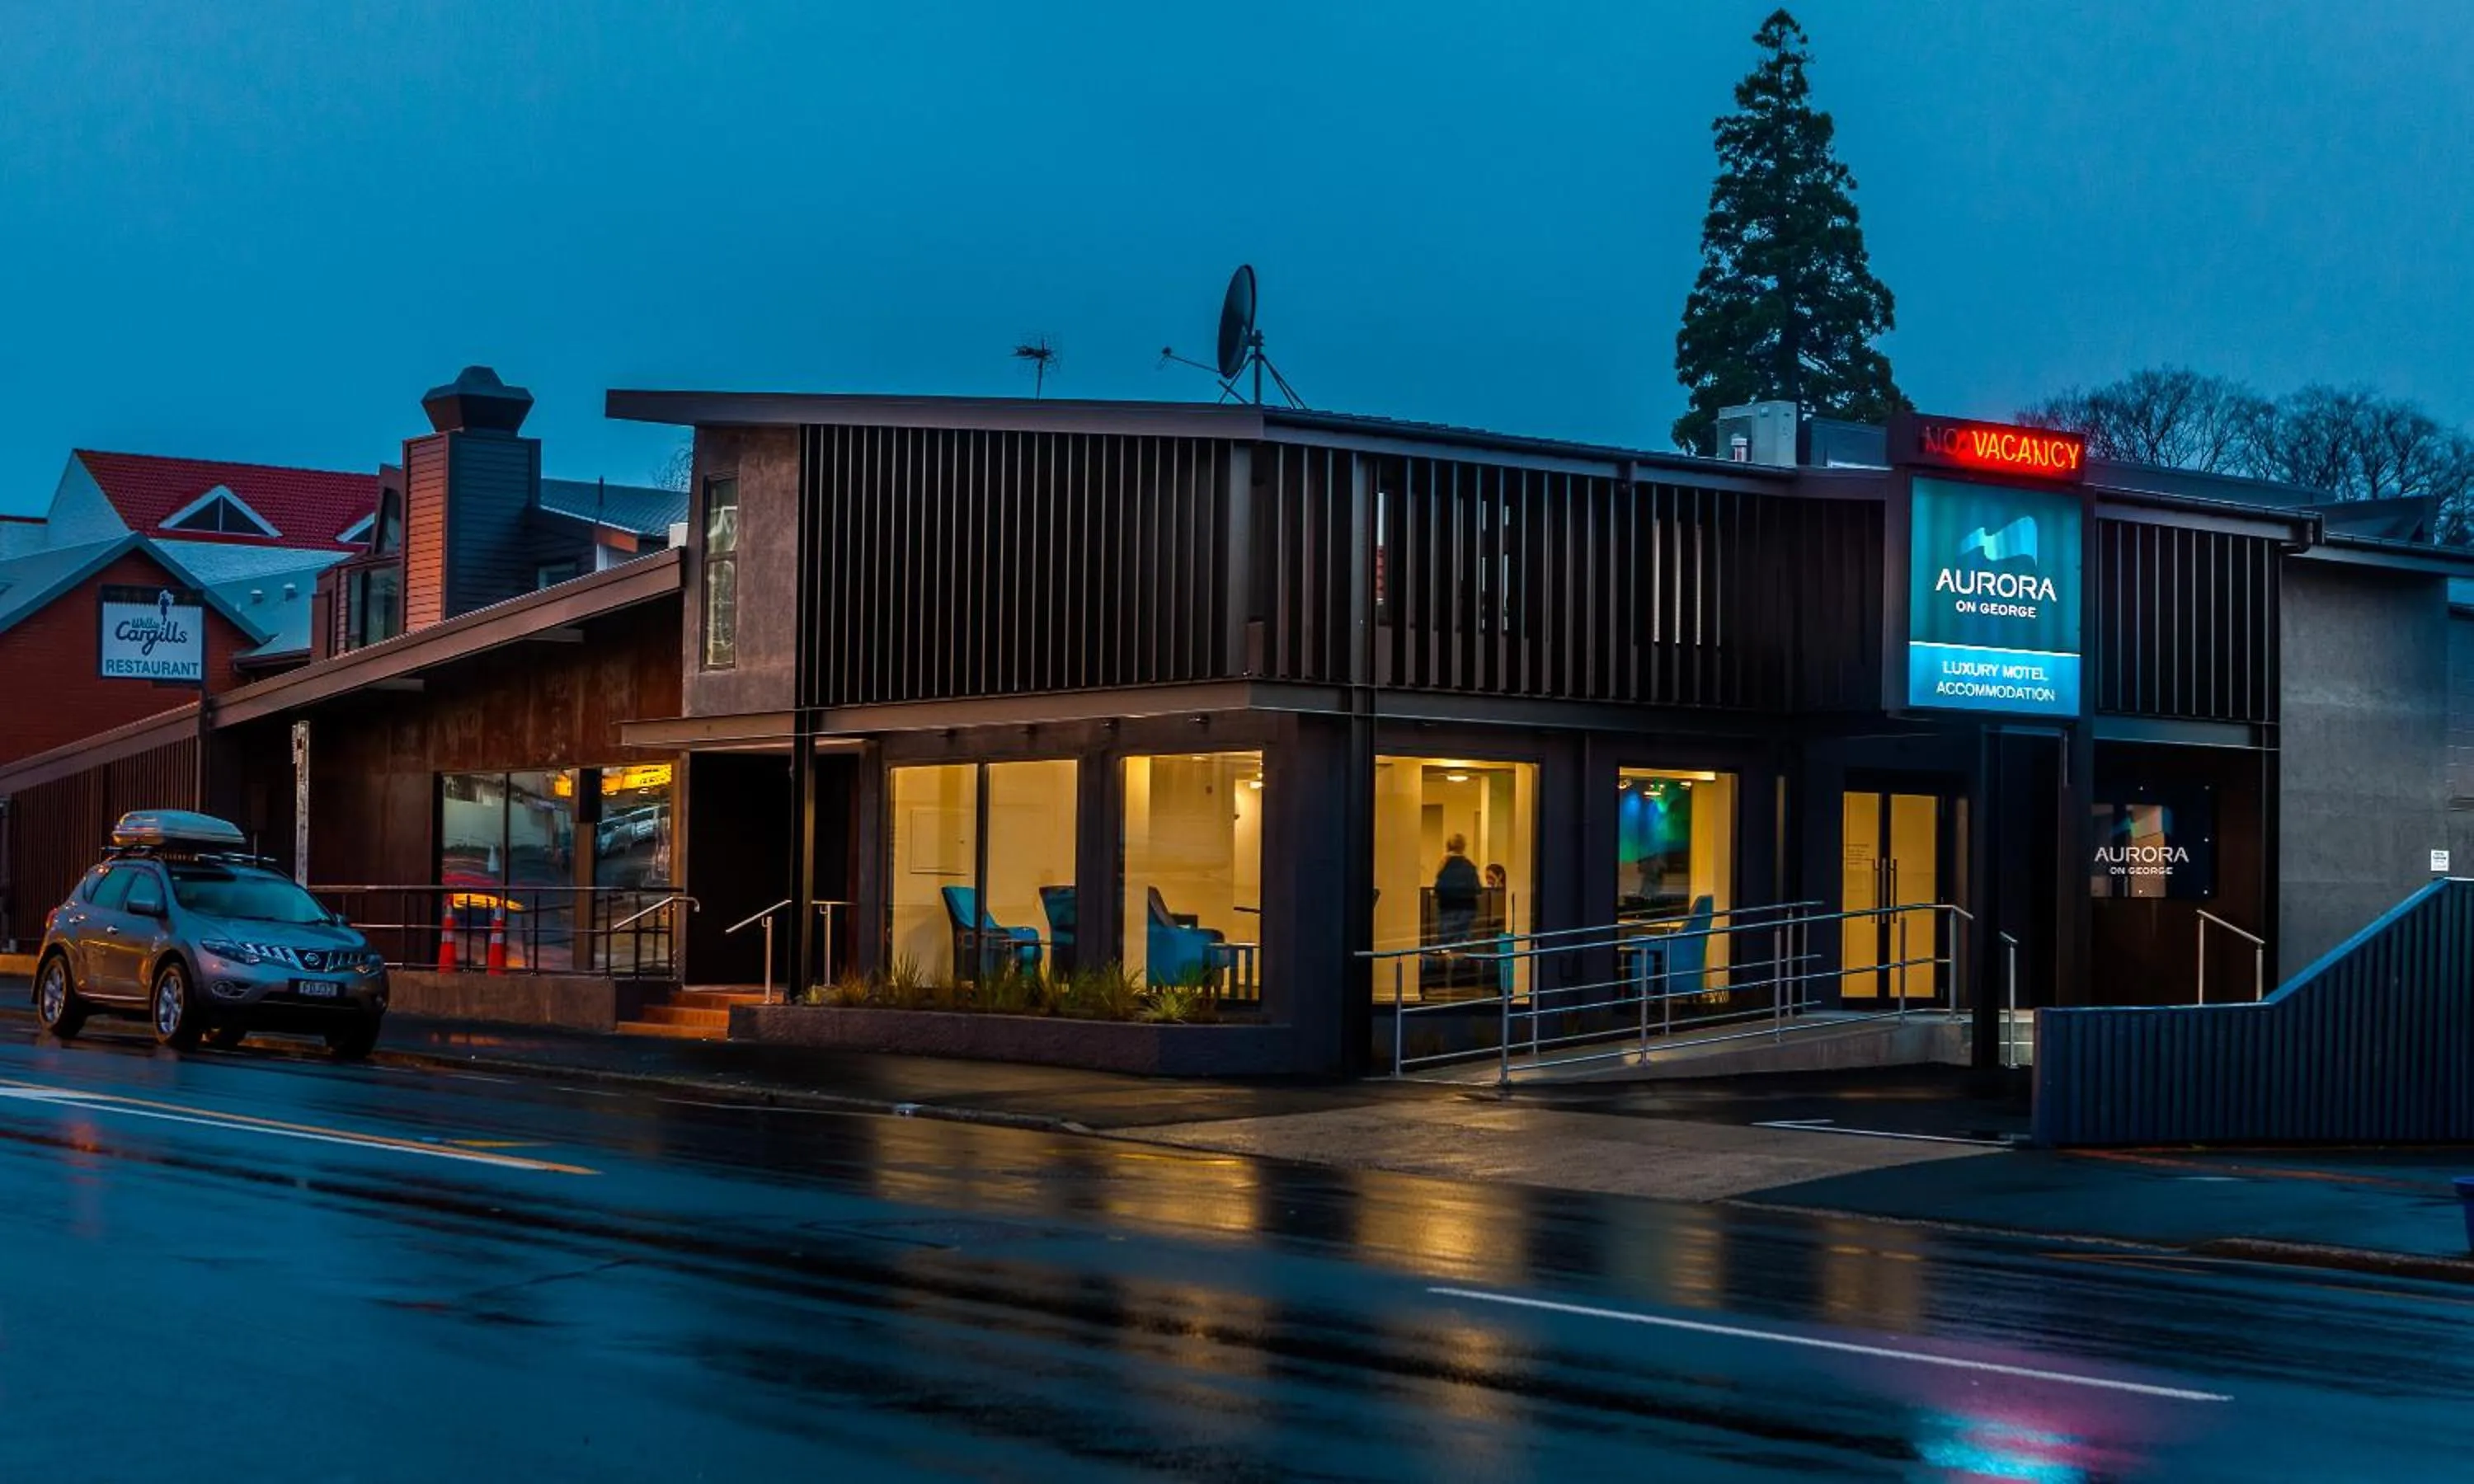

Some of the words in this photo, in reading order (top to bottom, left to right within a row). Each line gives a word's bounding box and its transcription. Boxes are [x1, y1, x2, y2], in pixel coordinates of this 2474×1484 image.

[1972, 430, 2079, 469] VACANCY
[1935, 568, 2057, 602] AURORA
[1955, 601, 1977, 614] ON
[1980, 603, 2037, 618] GEORGE
[115, 621, 187, 655] Cargills
[106, 660, 198, 674] RESTAURANT
[1942, 660, 2000, 677] LUXURY
[2002, 664, 2048, 681] MOTEL
[1935, 682, 2055, 702] ACCOMMODATION
[2094, 847, 2189, 862] AURORA
[2109, 866, 2125, 875] ON
